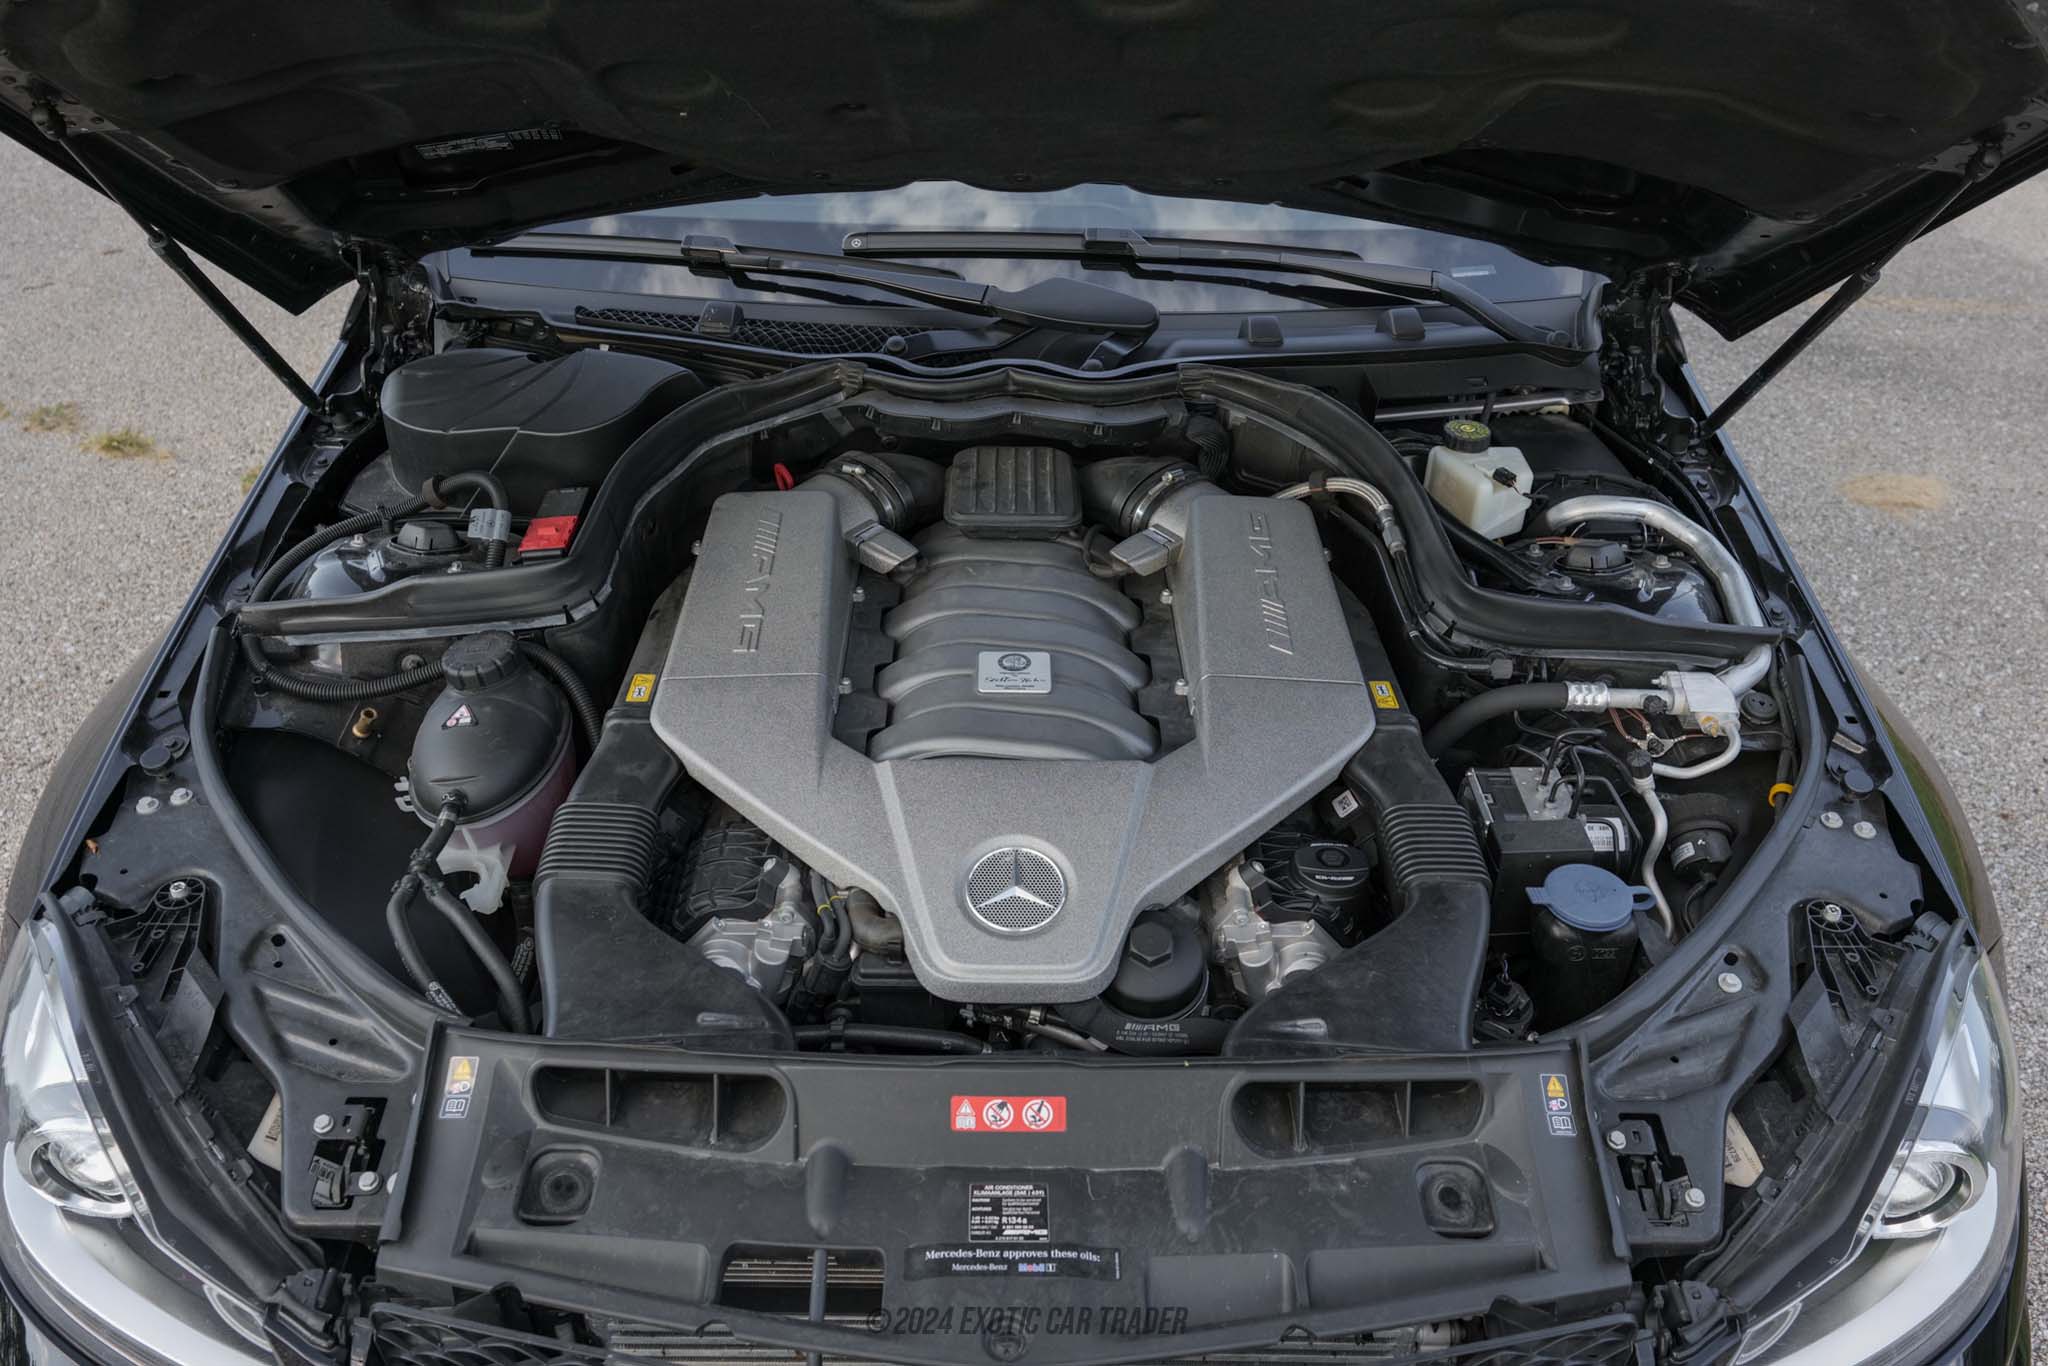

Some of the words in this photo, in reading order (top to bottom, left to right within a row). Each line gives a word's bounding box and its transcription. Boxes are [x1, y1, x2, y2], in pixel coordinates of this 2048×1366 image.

[1002, 1216, 1028, 1224] R134a
[925, 1249, 1000, 1260] Mercedes-Benz
[1003, 1250, 1047, 1260] approves
[1050, 1249, 1077, 1258] these
[1080, 1252, 1100, 1262] oils:
[952, 1263, 1008, 1271] Mercedes-Benz
